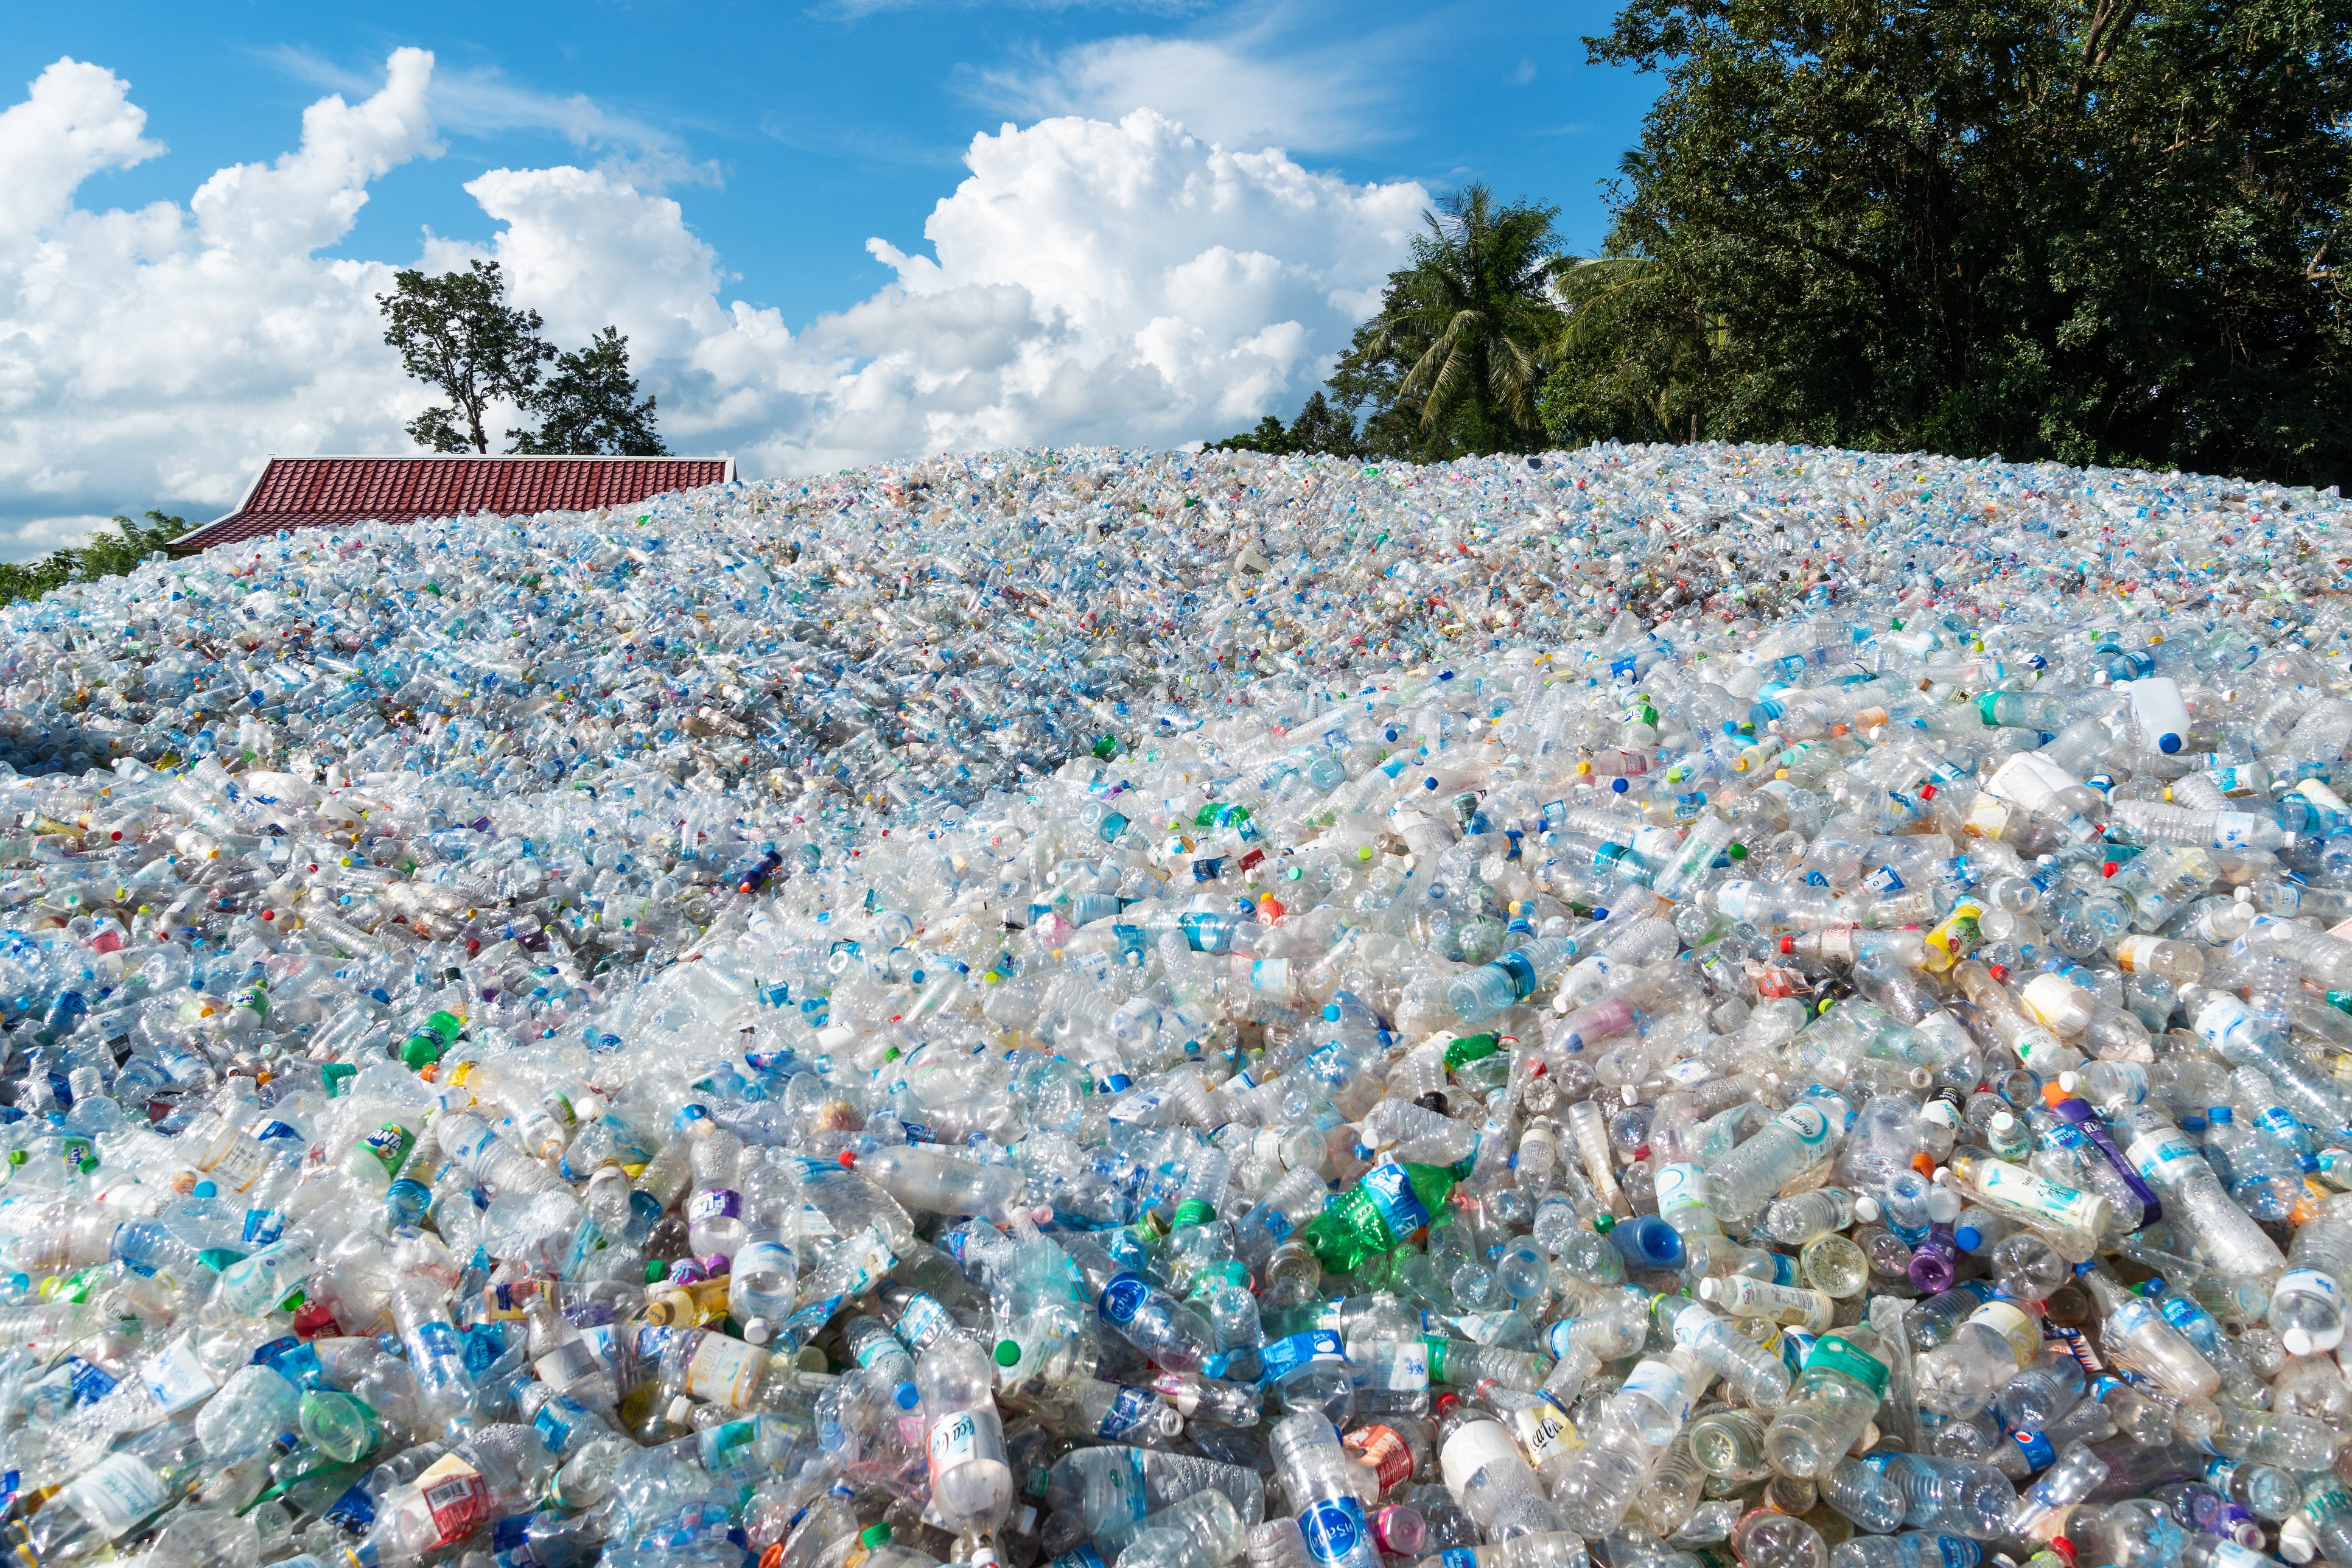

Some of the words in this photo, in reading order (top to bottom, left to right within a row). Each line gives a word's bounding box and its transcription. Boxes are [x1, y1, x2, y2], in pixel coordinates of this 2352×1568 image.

[1781, 1113, 1813, 1135] Chang
[365, 1129, 403, 1150] FANTA
[1369, 1173, 1402, 1196] Sprite
[1311, 1522, 1353, 1548] คริสตัล
